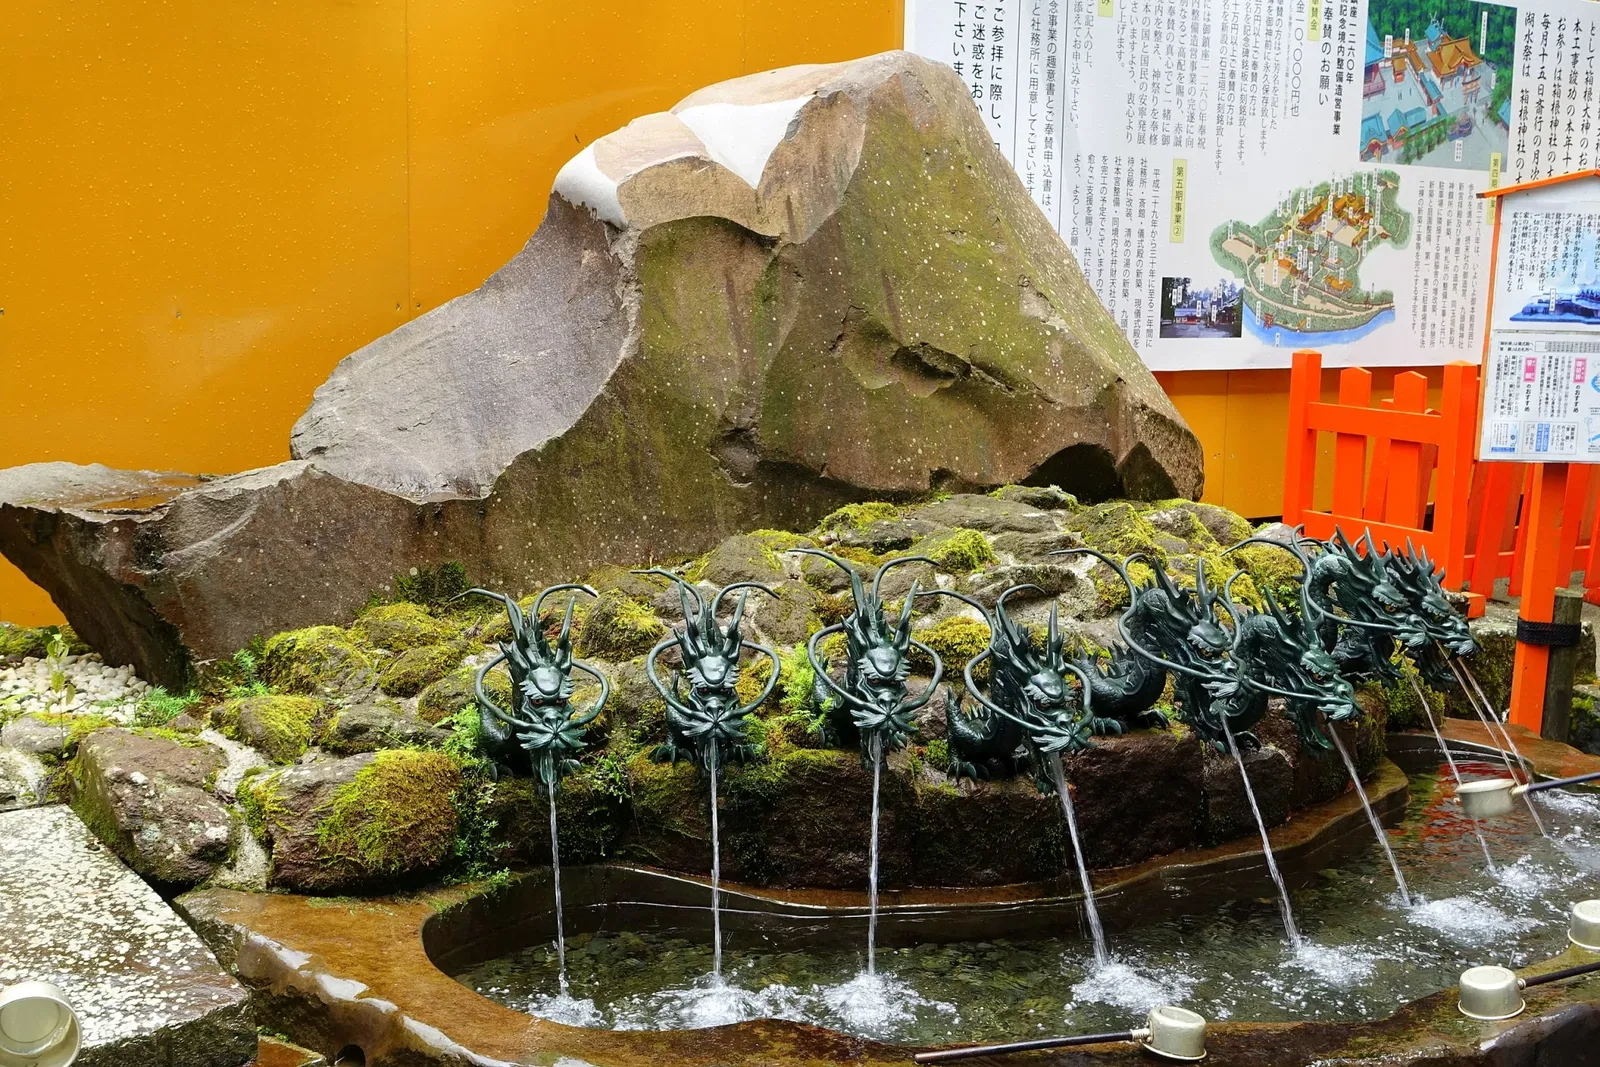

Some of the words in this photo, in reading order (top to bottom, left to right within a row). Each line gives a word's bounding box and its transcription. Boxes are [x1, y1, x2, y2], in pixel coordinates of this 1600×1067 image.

[989, 0, 1006, 151] ご参拝に際し、
[1083, 0, 1095, 68] ご記入の上、
[1136, 0, 1151, 145] 本の国と国民の安寧発展
[1148, 0, 1164, 146] 内を整え、神祭りを奉修
[1161, 0, 1178, 147] 奉賛の真心でご一緒に御
[1237, 0, 1252, 166] 名を記念碑銘板に刻銘致します。
[1249, 0, 1263, 117] 万円以上ご奉賛の方は
[1332, 0, 1348, 136] 記念境内整備造営事業
[1562, 17, 1583, 174] 本工事竣功の本年十
[1577, 21, 1597, 171] として箱根大神のお
